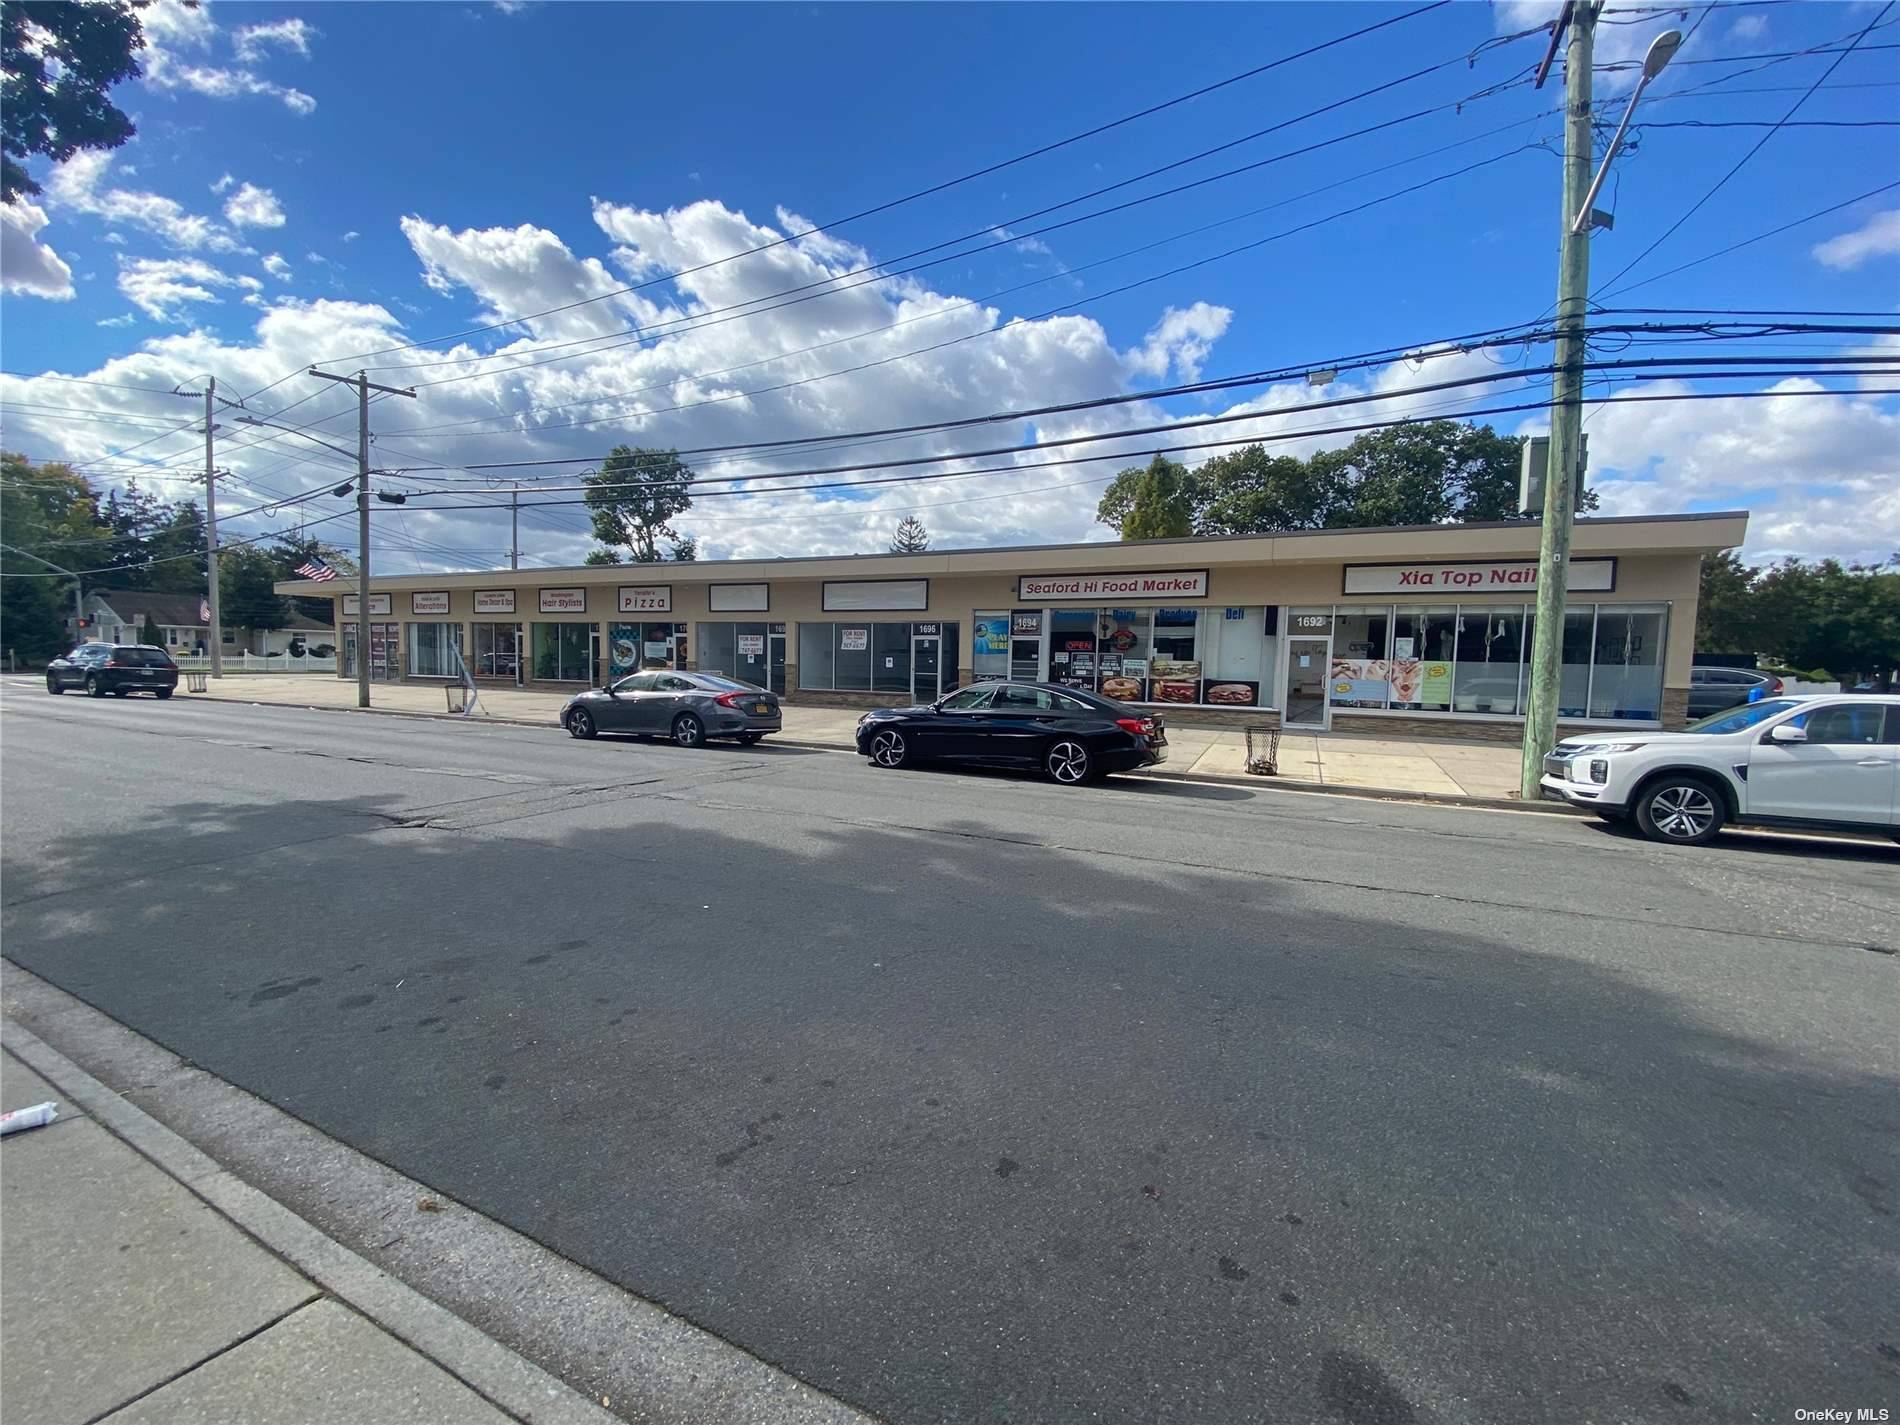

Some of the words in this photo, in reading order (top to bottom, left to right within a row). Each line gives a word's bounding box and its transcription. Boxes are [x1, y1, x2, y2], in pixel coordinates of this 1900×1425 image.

[1399, 571, 1433, 585] Xia
[1441, 570, 1483, 587] Top
[1490, 568, 1537, 584] Nail
[1026, 582, 1080, 594] Seaford
[1084, 581, 1098, 593] Hi
[1102, 580, 1139, 592] Food
[1142, 578, 1199, 591] Market
[543, 599, 557, 607] Hair
[558, 599, 582, 609] Stylists
[624, 597, 665, 608] Pizza
[1226, 608, 1245, 619] Deli
[1018, 618, 1037, 627] 1694
[1297, 617, 1322, 627] 1692
[920, 625, 936, 633] 1696
[1067, 641, 1091, 649] OPEN
